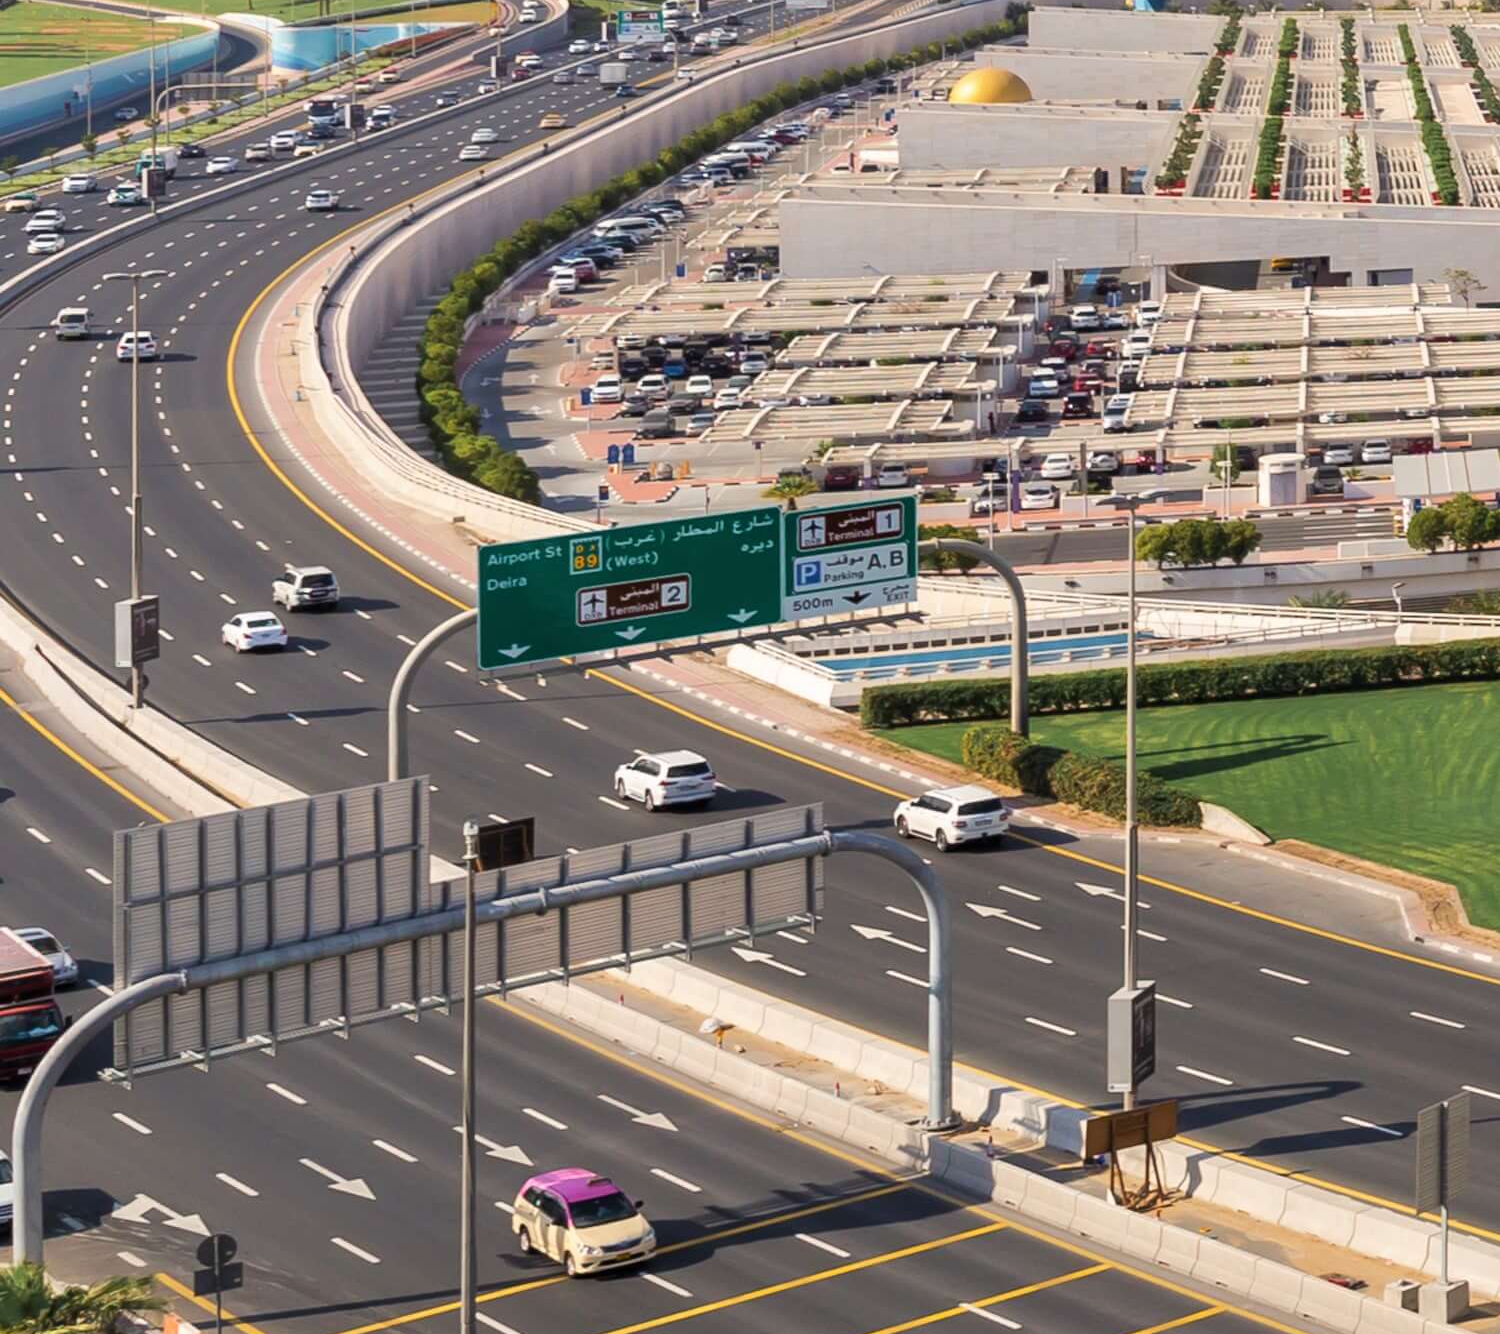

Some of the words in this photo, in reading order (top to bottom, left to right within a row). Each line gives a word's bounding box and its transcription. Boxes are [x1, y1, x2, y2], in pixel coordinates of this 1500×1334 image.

[732, 514, 774, 534] شارع
[885, 513, 892, 529] 1
[672, 520, 724, 542] المطار
[828, 528, 875, 542] Terminal
[487, 549, 541, 566] Airport
[545, 546, 563, 559] St
[606, 551, 659, 570] (West)
[574, 554, 598, 569] 89
[801, 564, 818, 584] P
[824, 570, 865, 583] Parking
[487, 577, 528, 591] Deira
[667, 586, 681, 603] 2
[887, 592, 909, 602] EXIT
[608, 601, 660, 616] Terminal
[793, 598, 833, 612] 500m
